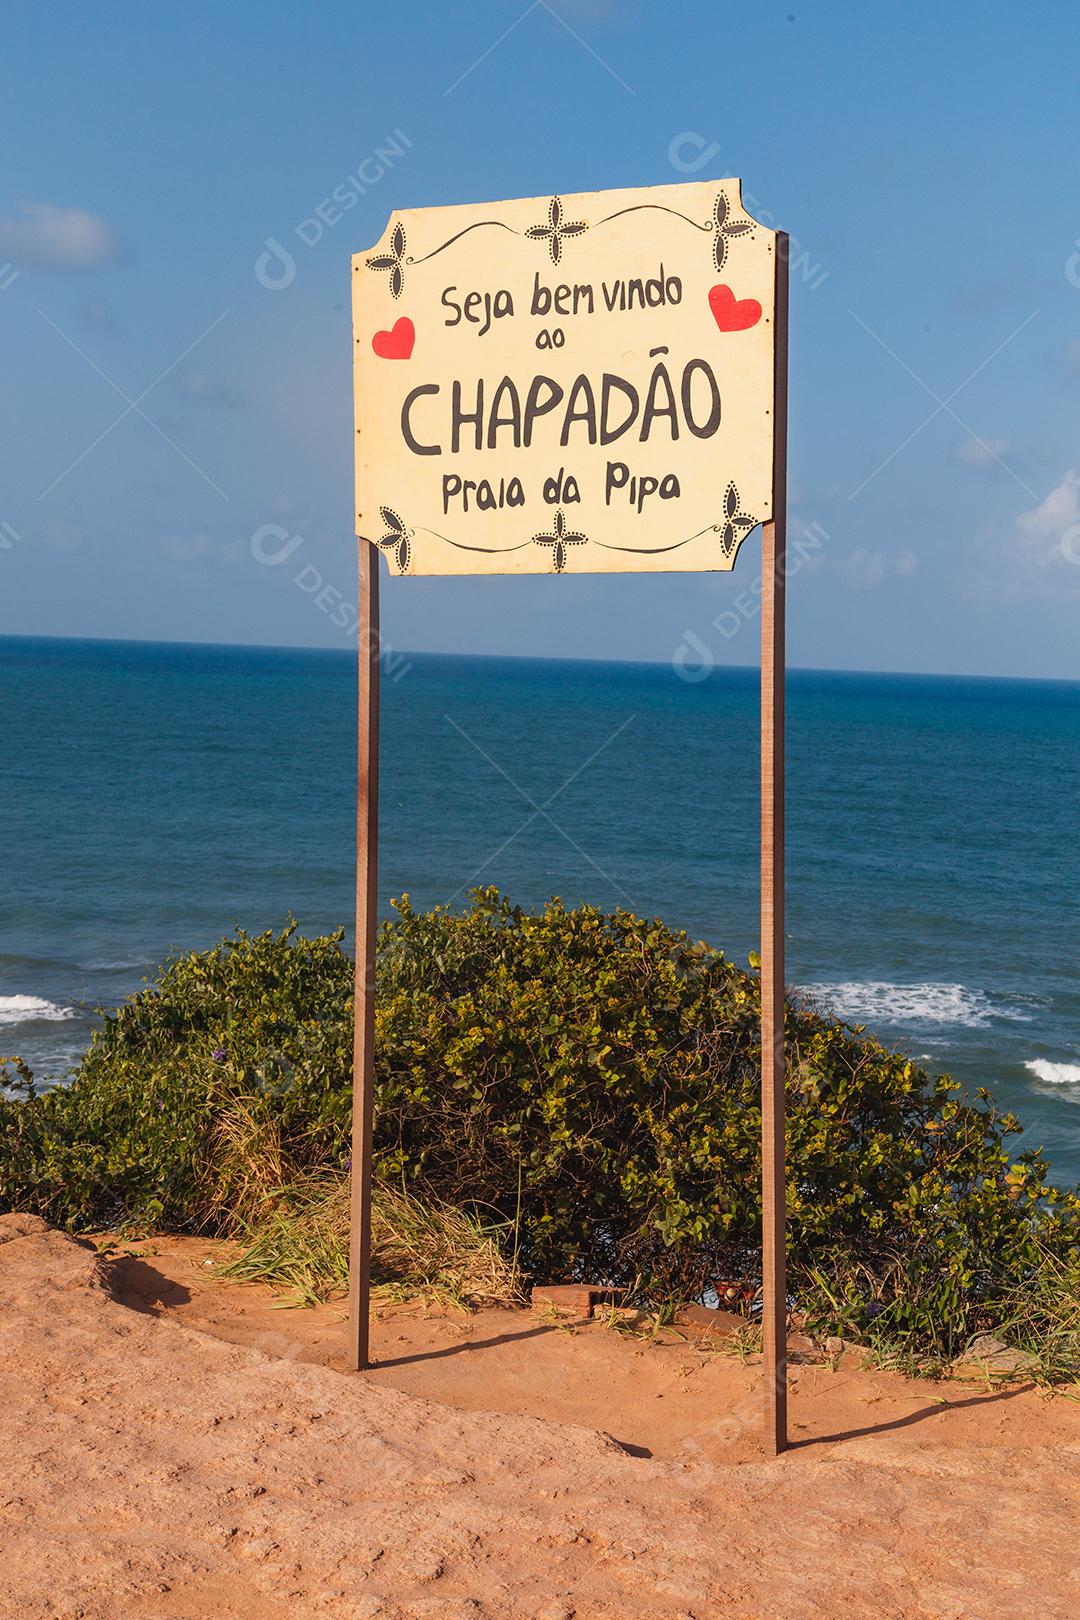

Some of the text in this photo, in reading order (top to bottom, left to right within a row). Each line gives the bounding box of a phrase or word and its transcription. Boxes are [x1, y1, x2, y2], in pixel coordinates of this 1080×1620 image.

[441, 262, 683, 337] Seja bem vindo
[535, 328, 566, 350] ao
[400, 346, 722, 456] CHAPADÃO
[442, 461, 682, 515] Praia da Pipa
